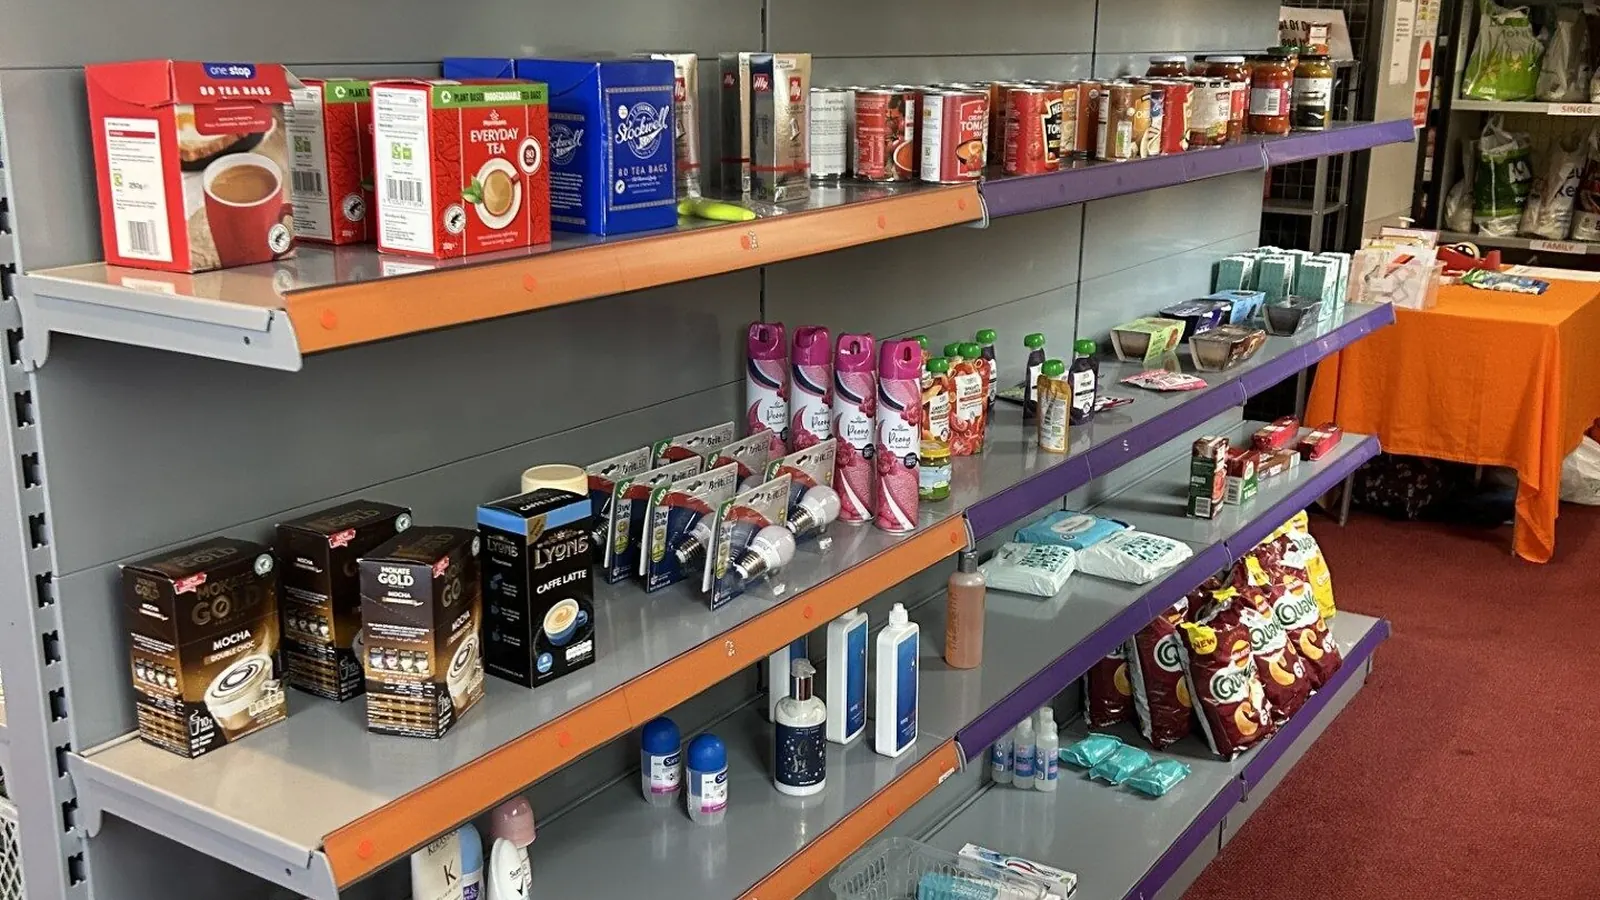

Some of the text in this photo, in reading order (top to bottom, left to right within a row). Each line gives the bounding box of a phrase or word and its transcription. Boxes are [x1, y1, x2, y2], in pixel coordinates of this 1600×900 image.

[210, 66, 251, 78] one stop
[754, 75, 769, 90] illy
[200, 86, 271, 96] 80 TEA BAGS
[1561, 105, 1593, 114] SINGLE
[615, 105, 670, 144] Stockwell
[470, 127, 519, 143] EVERYDAY
[486, 142, 506, 155] TEA
[618, 163, 668, 177] 80 TEA BAGS
[1542, 241, 1574, 252] FAMILY
[534, 535, 589, 570] LYONS
[377, 573, 415, 586] GOLD
[536, 569, 587, 594] CAFFE LATTE
[213, 629, 252, 650] MOCHA
[1194, 637, 1215, 650] NEW
[443, 859, 456, 886] K
